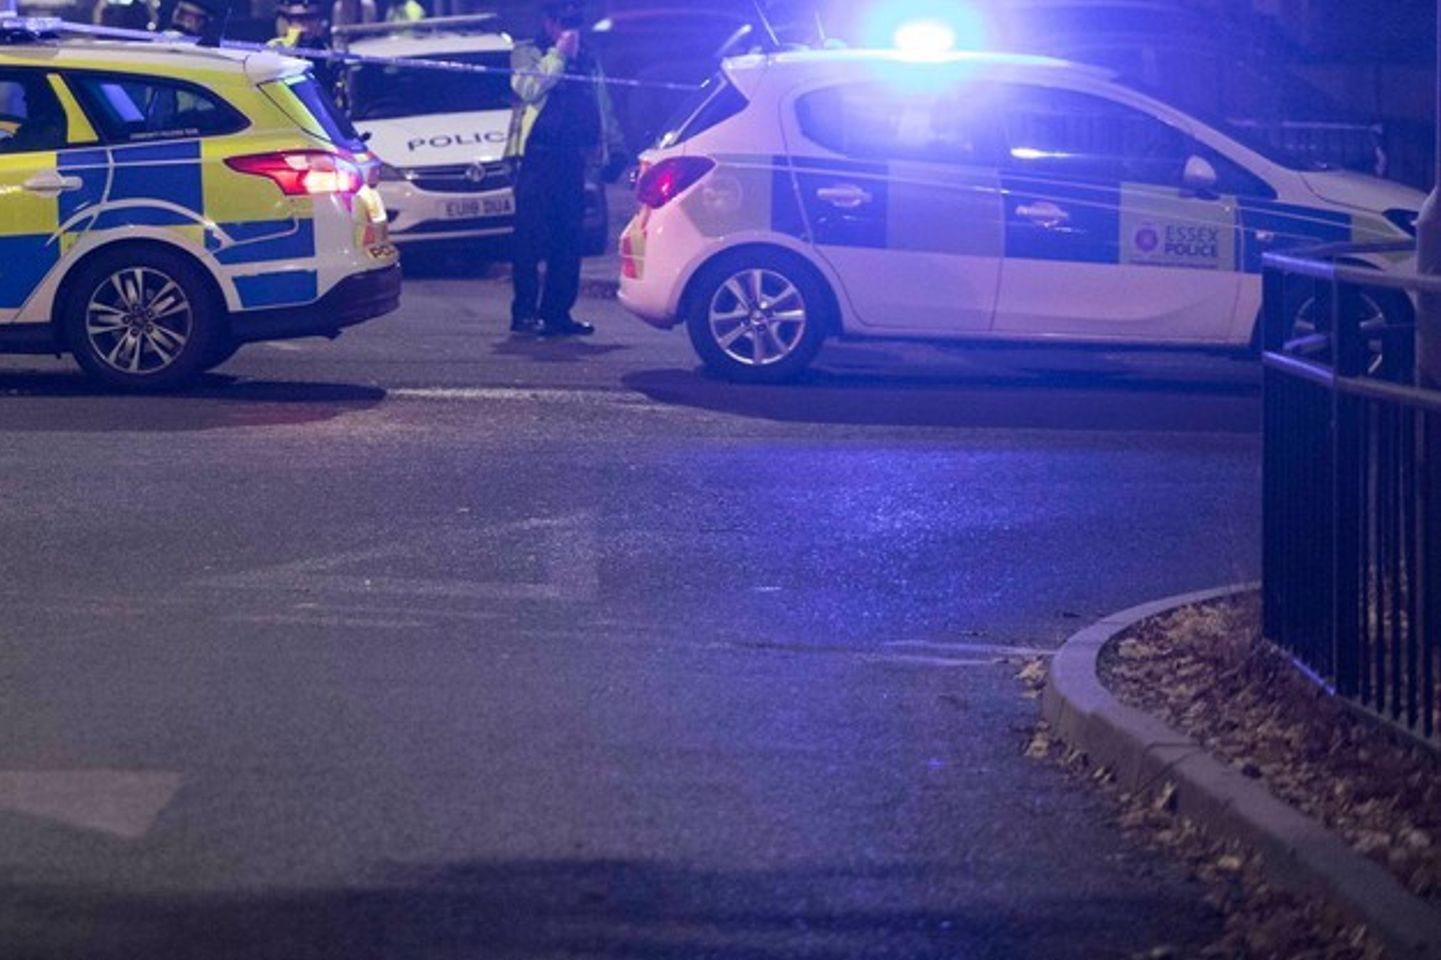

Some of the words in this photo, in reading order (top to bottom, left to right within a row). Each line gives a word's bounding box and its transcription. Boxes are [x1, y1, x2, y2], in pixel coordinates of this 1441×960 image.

[407, 131, 506, 151] POLIC
[1165, 225, 1218, 241] ESSEX
[1165, 243, 1217, 257] POLICE
